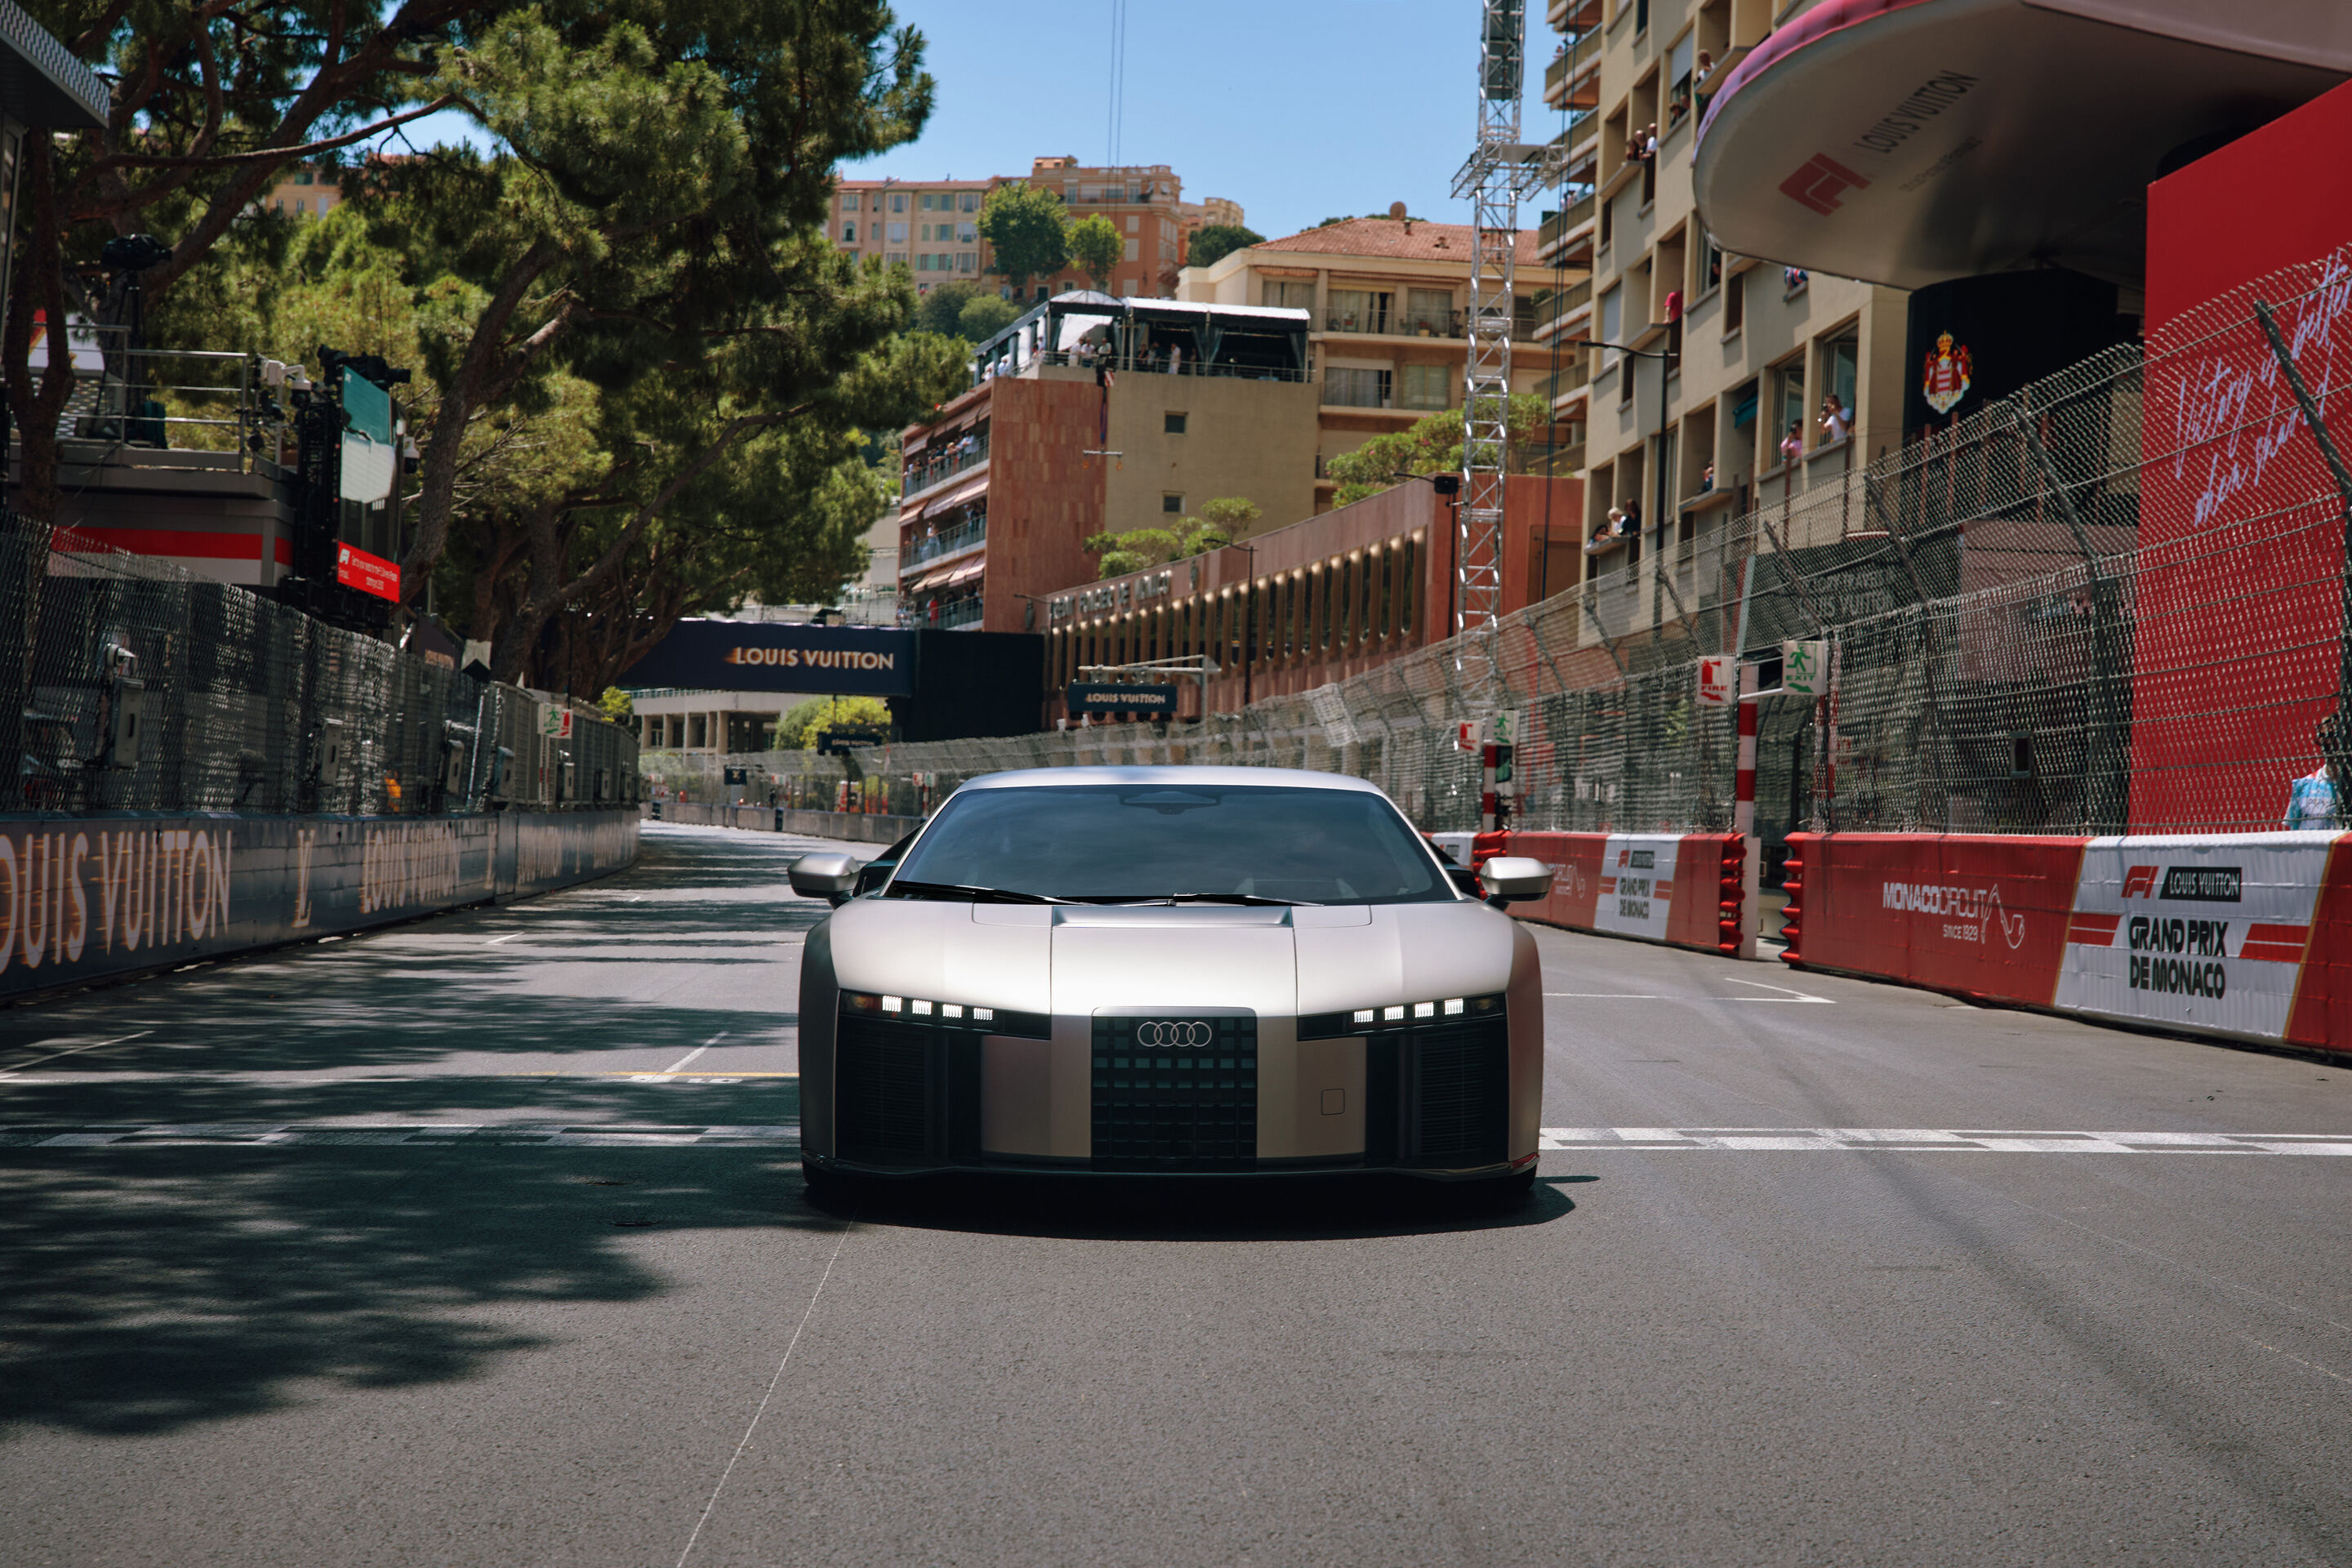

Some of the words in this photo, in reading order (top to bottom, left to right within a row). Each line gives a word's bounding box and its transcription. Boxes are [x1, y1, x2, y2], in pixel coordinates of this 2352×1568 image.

[1853, 118, 1921, 154] LOUIS
[1890, 69, 1981, 122] VUITTON
[2255, 341, 2334, 485] shard
[735, 647, 799, 667] LOUIS
[804, 649, 894, 670] VUITTON
[1086, 693, 1118, 703] LOUIS
[1120, 693, 1165, 704] VUITTON
[361, 828, 407, 914] LOUIS
[2169, 872, 2197, 895] LOUIS
[2198, 873, 2240, 897] VUITTON
[100, 830, 232, 956] VUITTON
[1942, 924, 1962, 939] SINCE
[1962, 924, 1979, 942] 1929
[2130, 916, 2185, 953] GRAND
[2187, 920, 2229, 957] PRIX
[2130, 955, 2150, 990] DE
[2152, 957, 2226, 1000] MONACO
